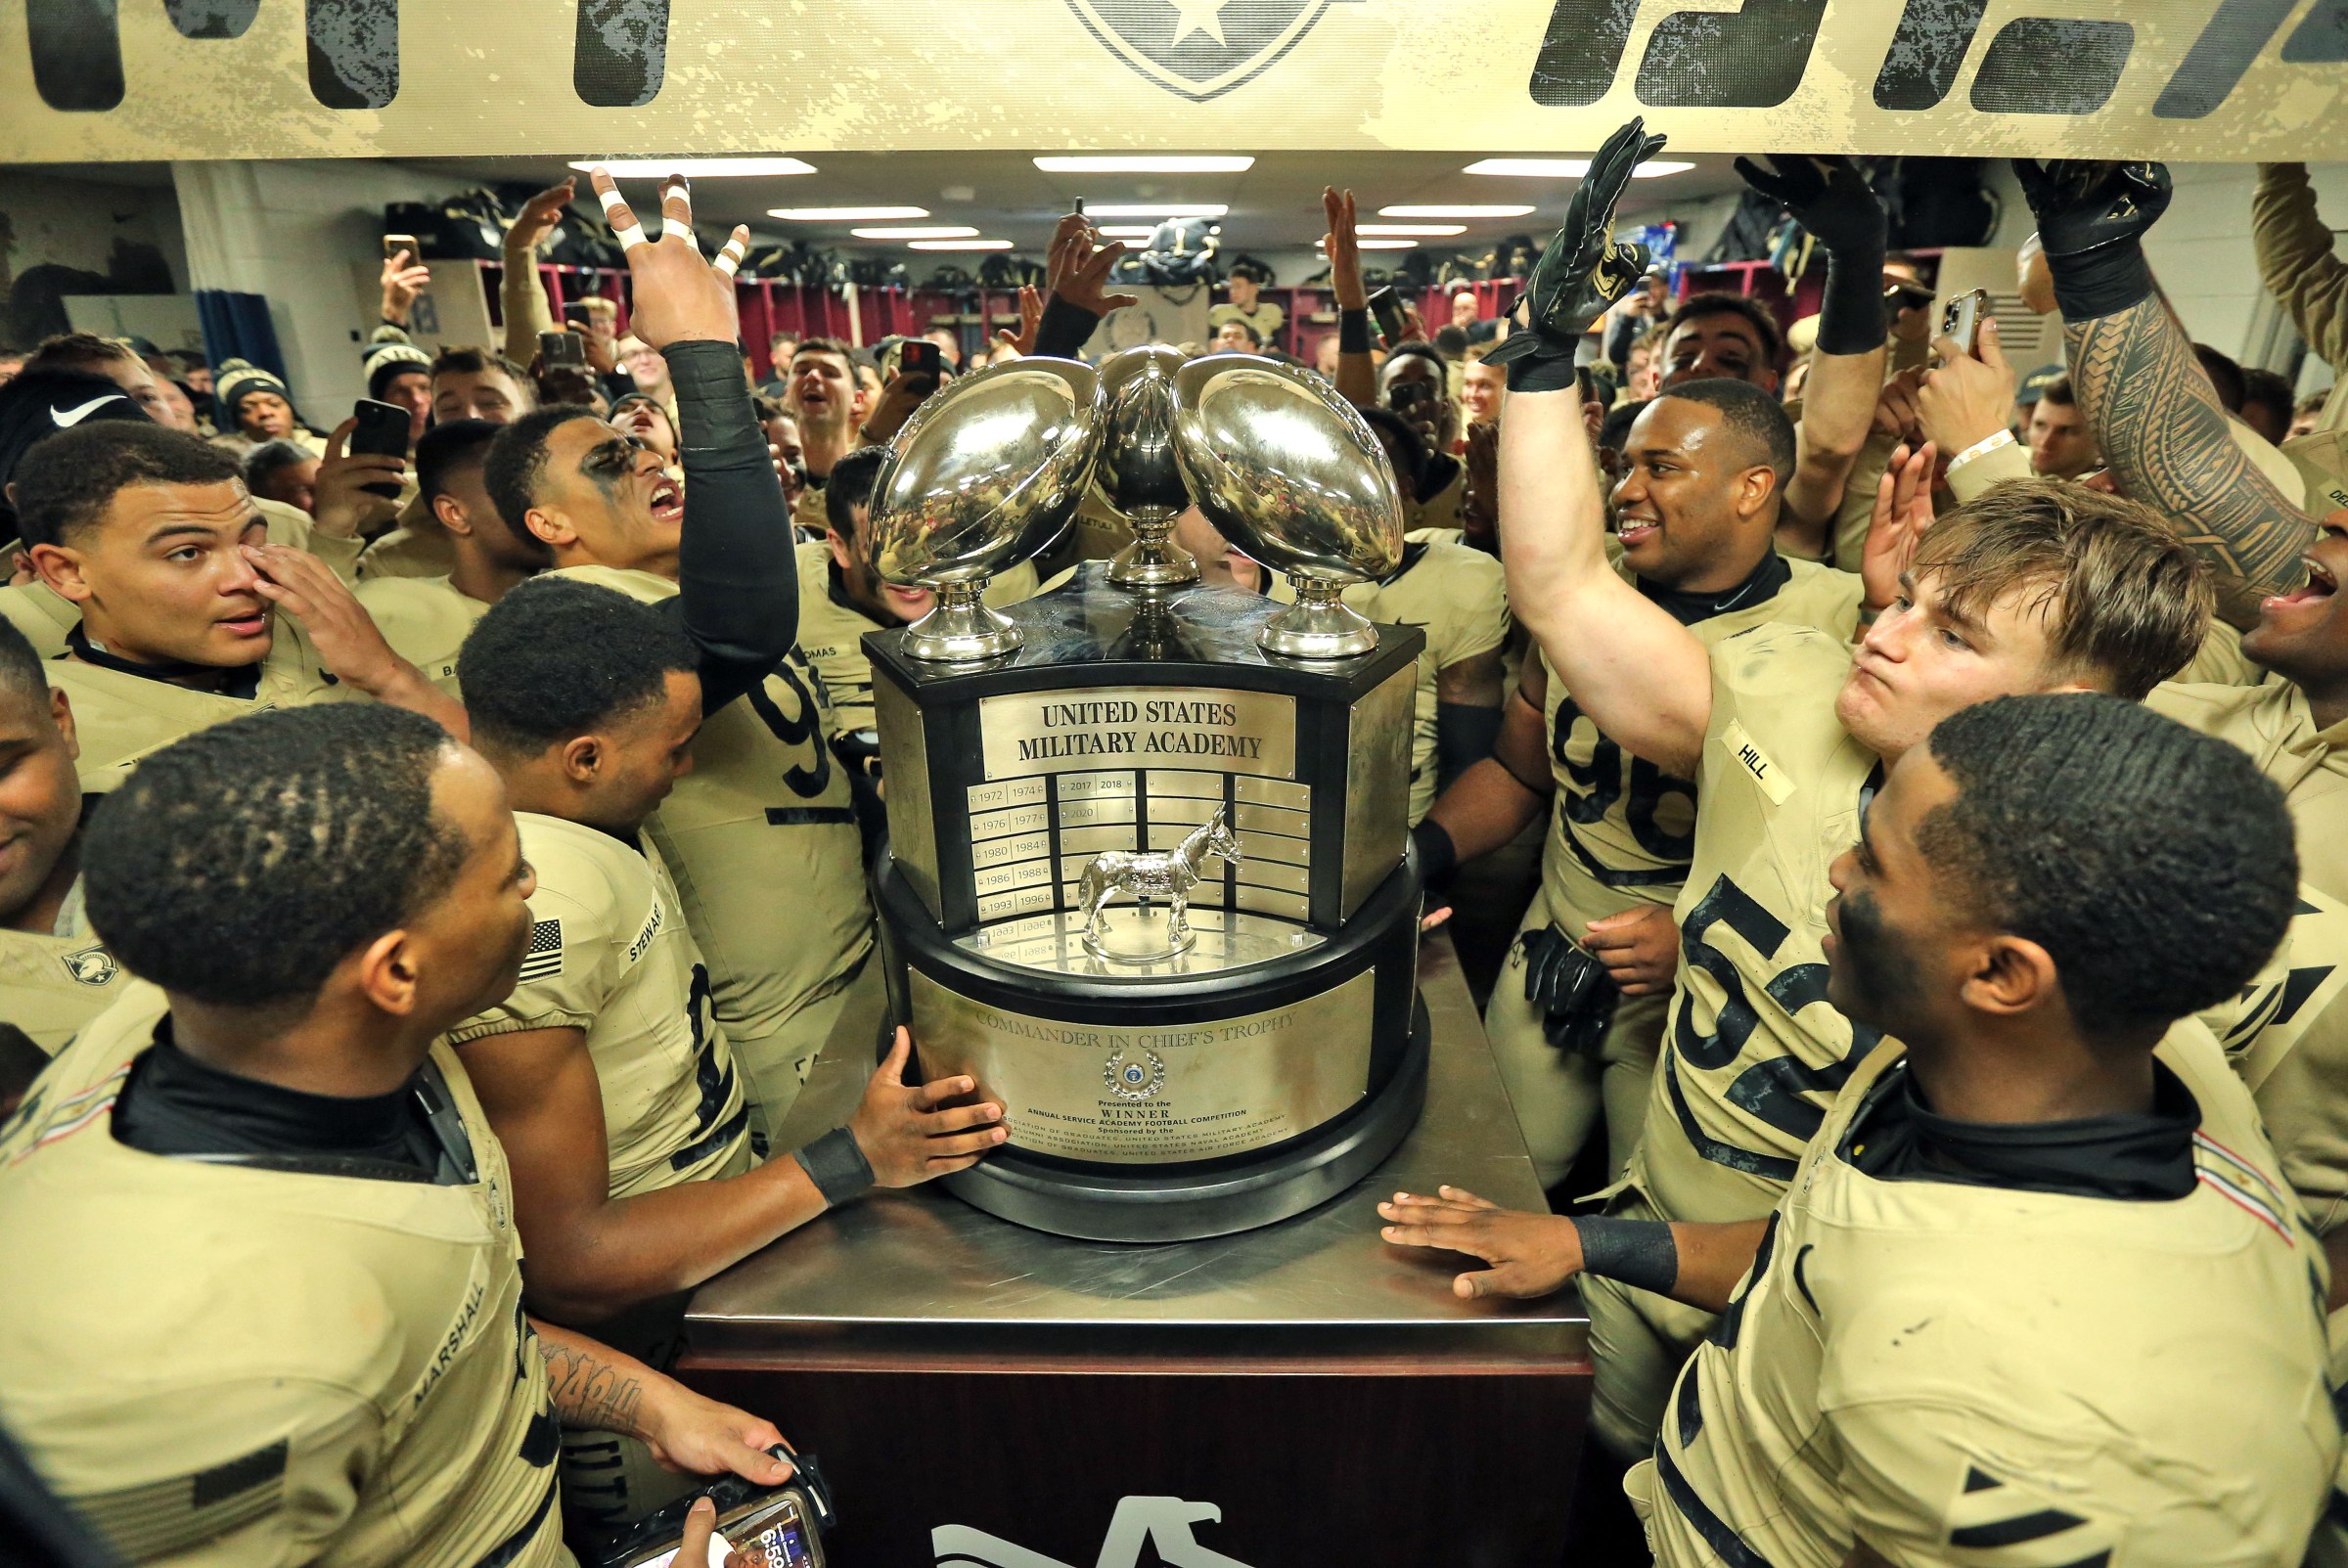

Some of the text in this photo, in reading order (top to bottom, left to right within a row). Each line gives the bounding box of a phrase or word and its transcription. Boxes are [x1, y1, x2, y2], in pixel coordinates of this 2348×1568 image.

[803, 647, 837, 660] OMAS
[1042, 700, 1237, 728] UNITED STATES
[1017, 731, 1262, 761] MILITARY ACADEMY
[1738, 743, 1767, 780] HILL
[979, 787, 1035, 802] 1972 1974
[1070, 782, 1092, 790] 2017
[982, 814, 1038, 830] 1976 1977
[1071, 809, 1094, 818] 2020
[983, 841, 1040, 858] 1980 1984
[986, 868, 1042, 885] 1986 1988
[989, 895, 1044, 912] 1993 1996
[629, 903, 662, 963] STEWART
[976, 1010, 1297, 1049] COMMANDER IN CHIEF'S TROPHY
[1098, 1099, 1142, 1108] Presented
[1027, 1107, 1061, 1120] ANNUAL
[1062, 1115, 1097, 1125] SERVICE
[1191, 1109, 1247, 1124] COMPETITION
[1101, 1109, 1170, 1119] WINNER
[1003, 1115, 1046, 1131] SOCIATION
[1201, 1126, 1242, 1138] MILITARY
[1246, 1114, 1287, 1129] ACADEMY
[1013, 1126, 1044, 1138] ALUMNI
[1191, 1138, 1219, 1146] NAVAL
[1222, 1128, 1264, 1142] ACADEMY
[1217, 1139, 1246, 1149] FORCE
[414, 1281, 483, 1411] MARSHALL
[760, 1528, 785, 1568] 6:59
